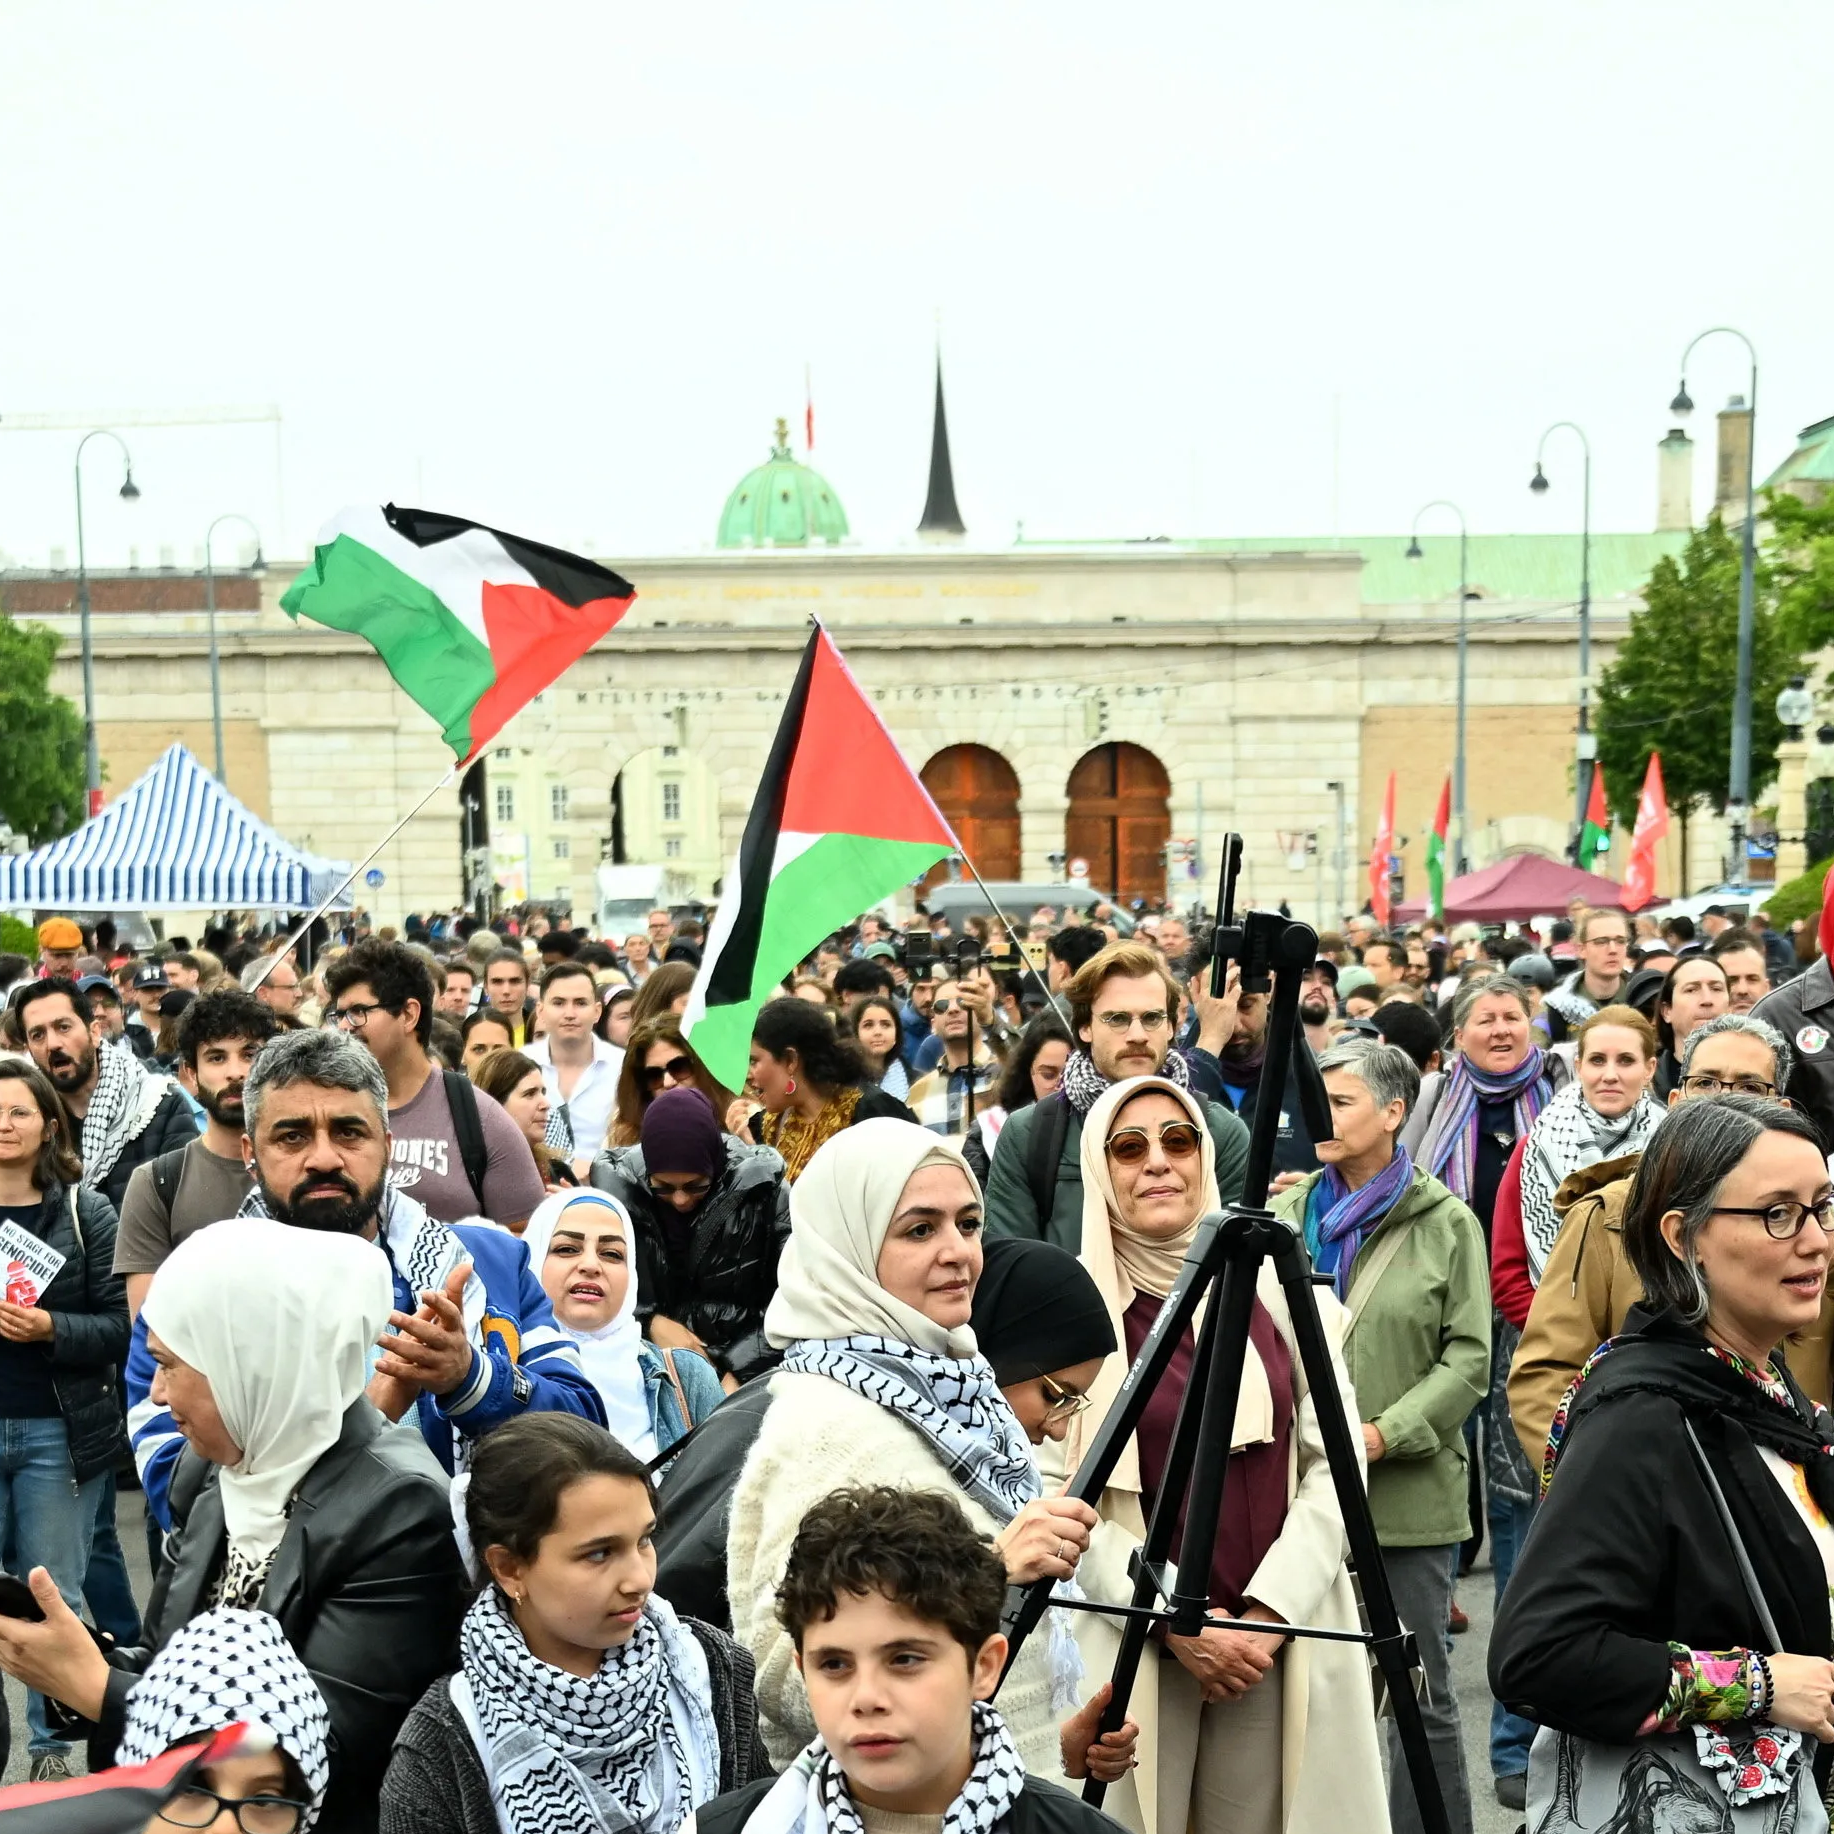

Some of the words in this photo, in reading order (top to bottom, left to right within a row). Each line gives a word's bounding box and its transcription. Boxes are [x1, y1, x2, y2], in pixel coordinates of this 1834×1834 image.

[2, 1225, 16, 1238] NO
[16, 1233, 45, 1257] STAGE
[43, 1251, 63, 1269] FOR
